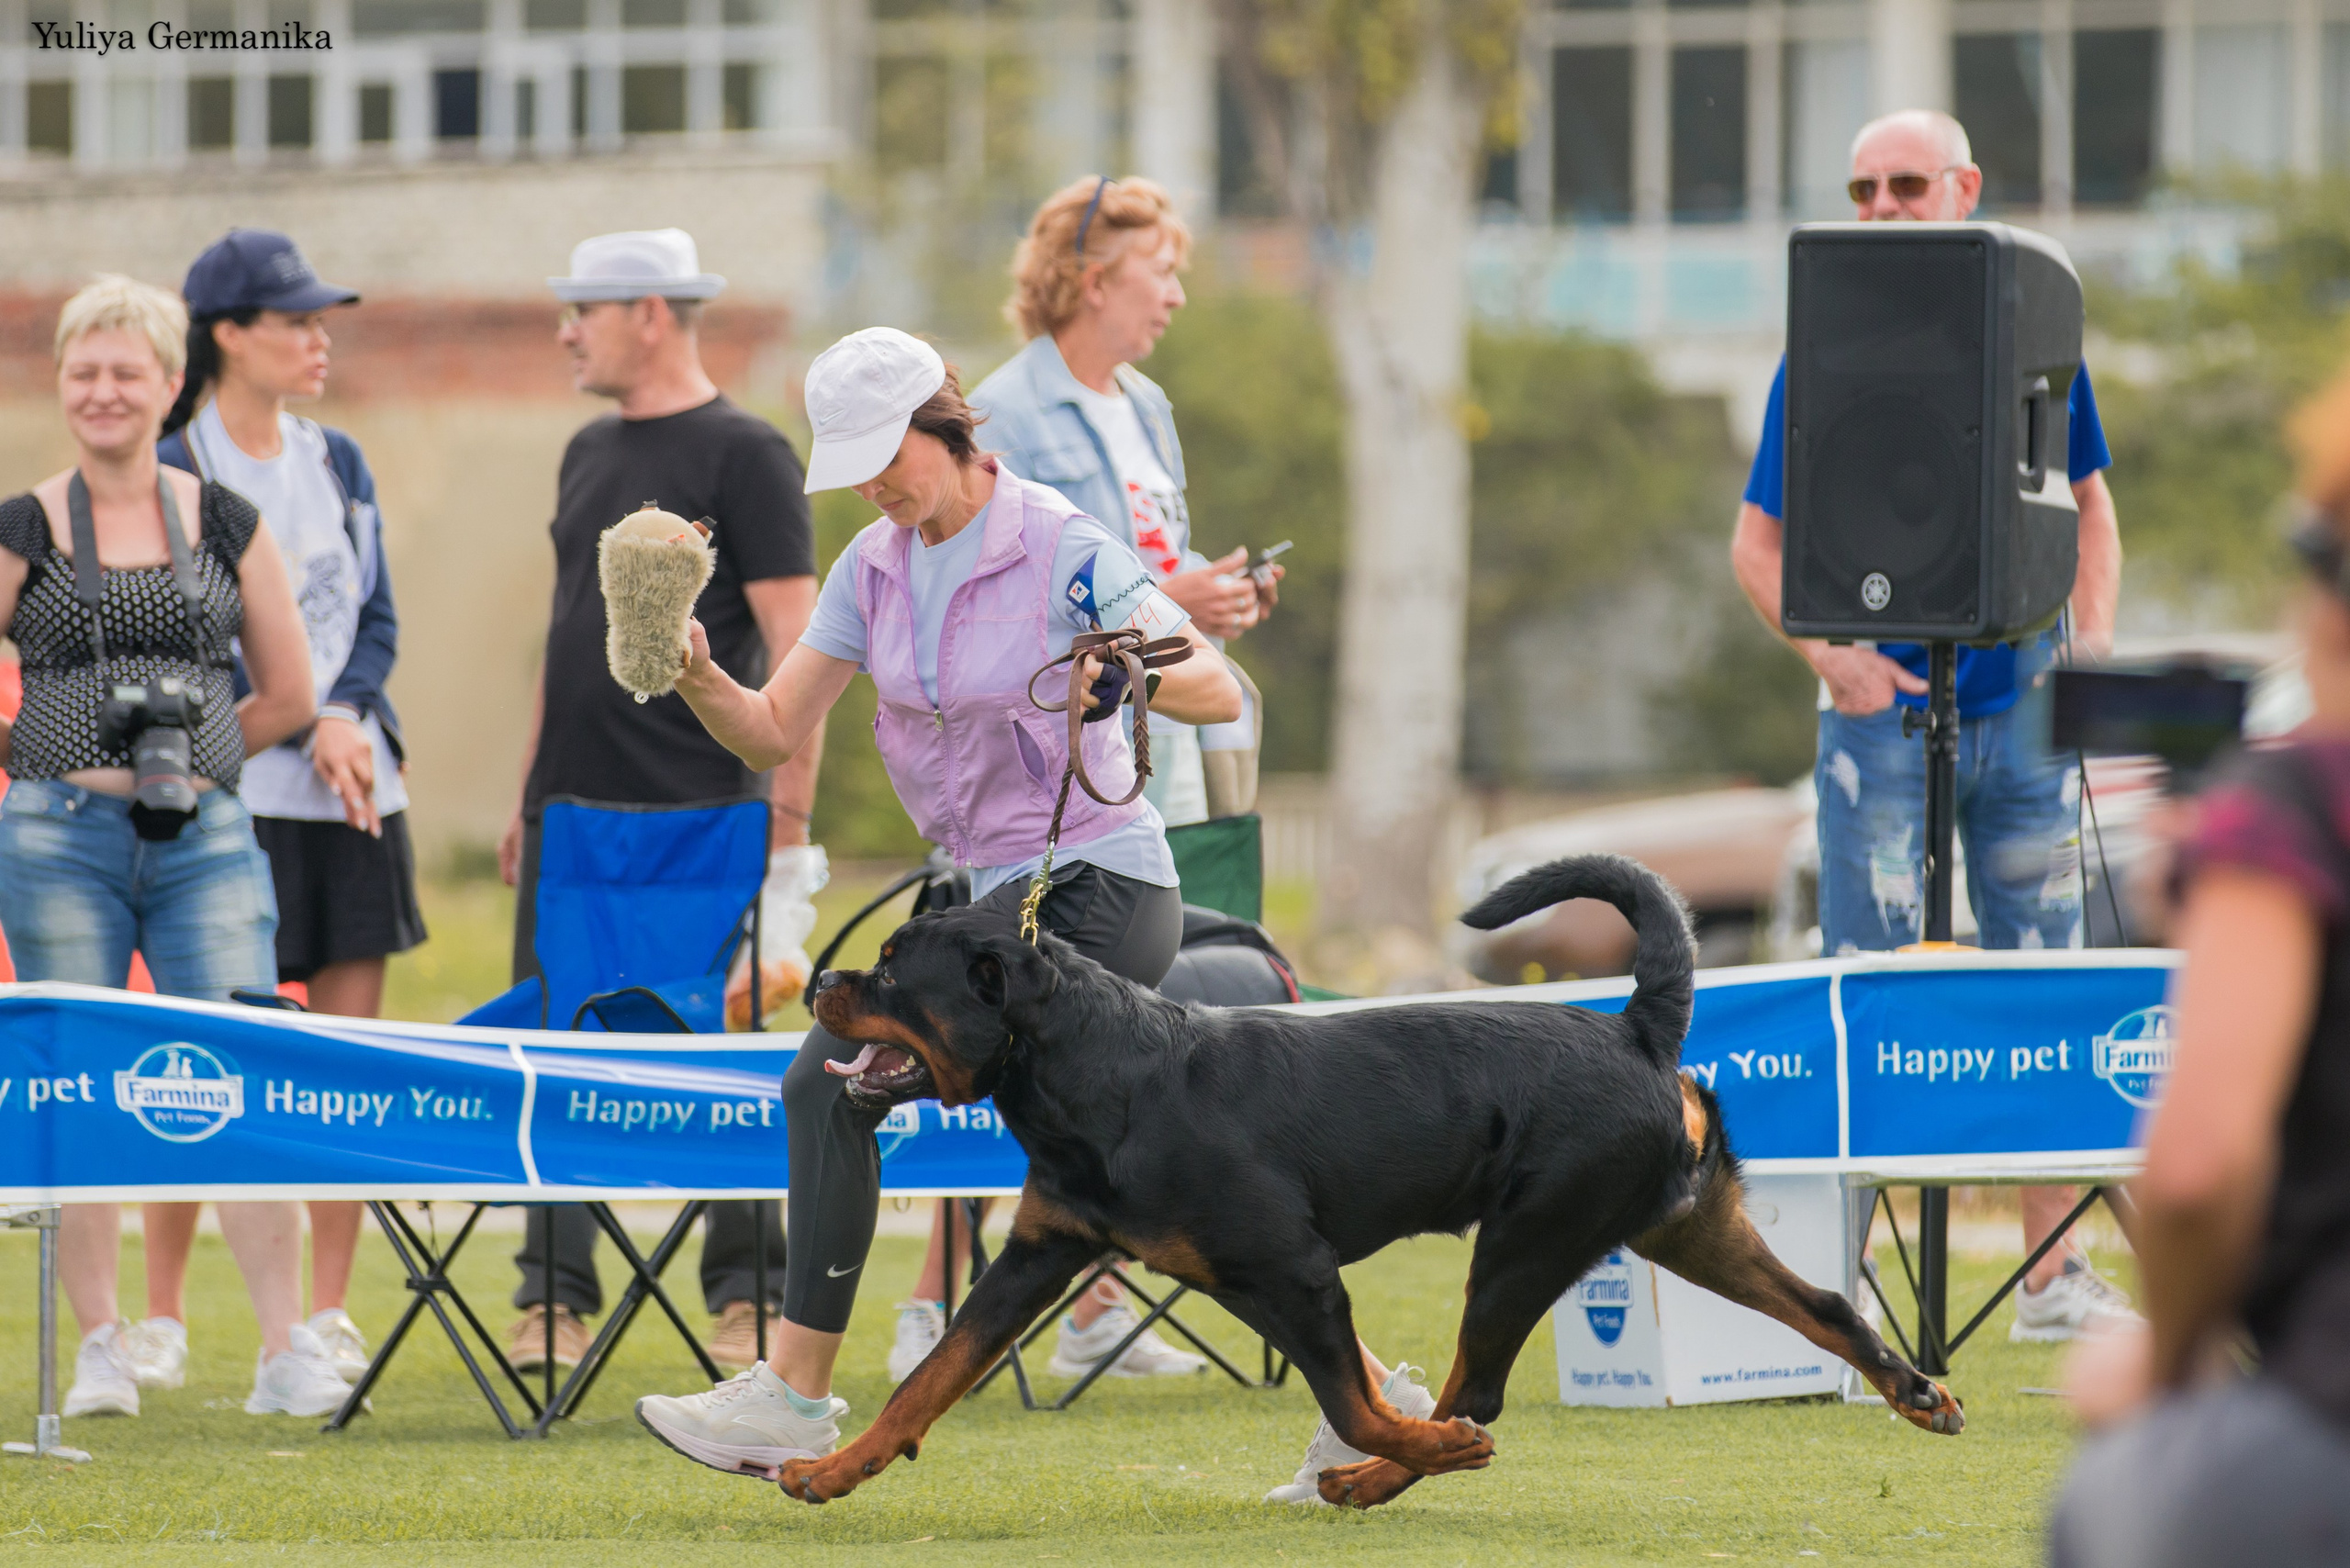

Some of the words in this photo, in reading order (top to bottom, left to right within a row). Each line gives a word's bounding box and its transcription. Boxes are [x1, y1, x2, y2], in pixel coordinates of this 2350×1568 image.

[1728, 1048, 1812, 1079] You.
[1878, 1041, 1995, 1081] Happy
[2010, 1039, 2071, 1079] pet
[28, 1072, 95, 1112] pet
[128, 1081, 229, 1107] Farmina
[265, 1078, 393, 1127] Happy
[409, 1085, 494, 1121] You.
[568, 1090, 695, 1133] Happy
[711, 1098, 776, 1132] pet
[1702, 1363, 1822, 1384] www.farmina.com
